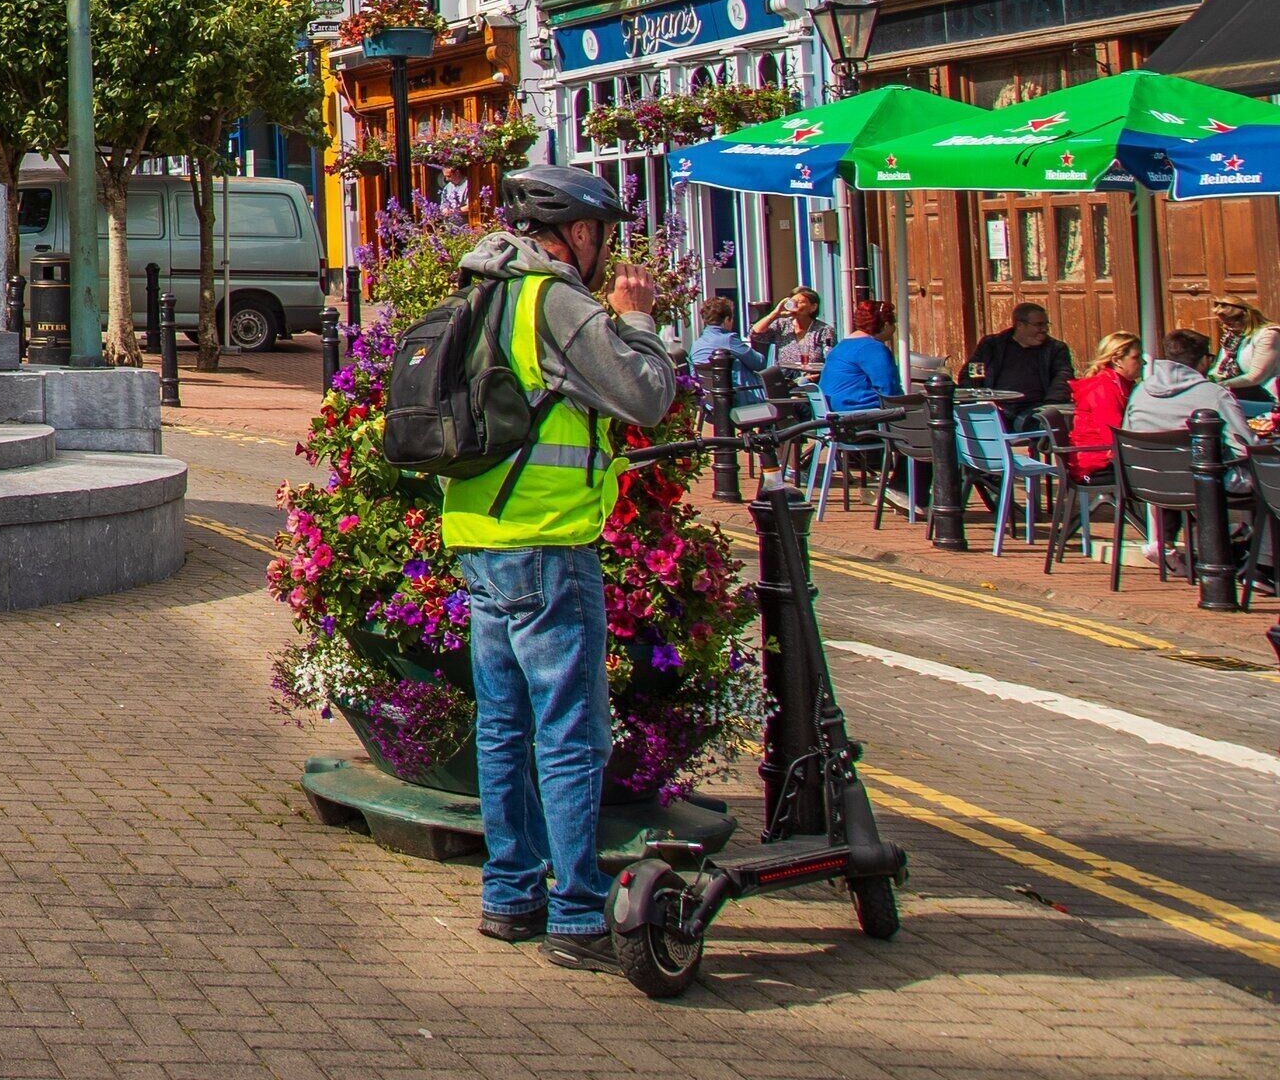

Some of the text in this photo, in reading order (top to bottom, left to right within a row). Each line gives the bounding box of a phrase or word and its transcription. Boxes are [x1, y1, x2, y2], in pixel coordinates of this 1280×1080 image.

[621, 3, 702, 59] Ryan's
[877, 171, 911, 181] Heineken
[1045, 170, 1088, 180] Heineken
[1199, 173, 1262, 186] Heineken
[38, 323, 67, 331] LITTER
